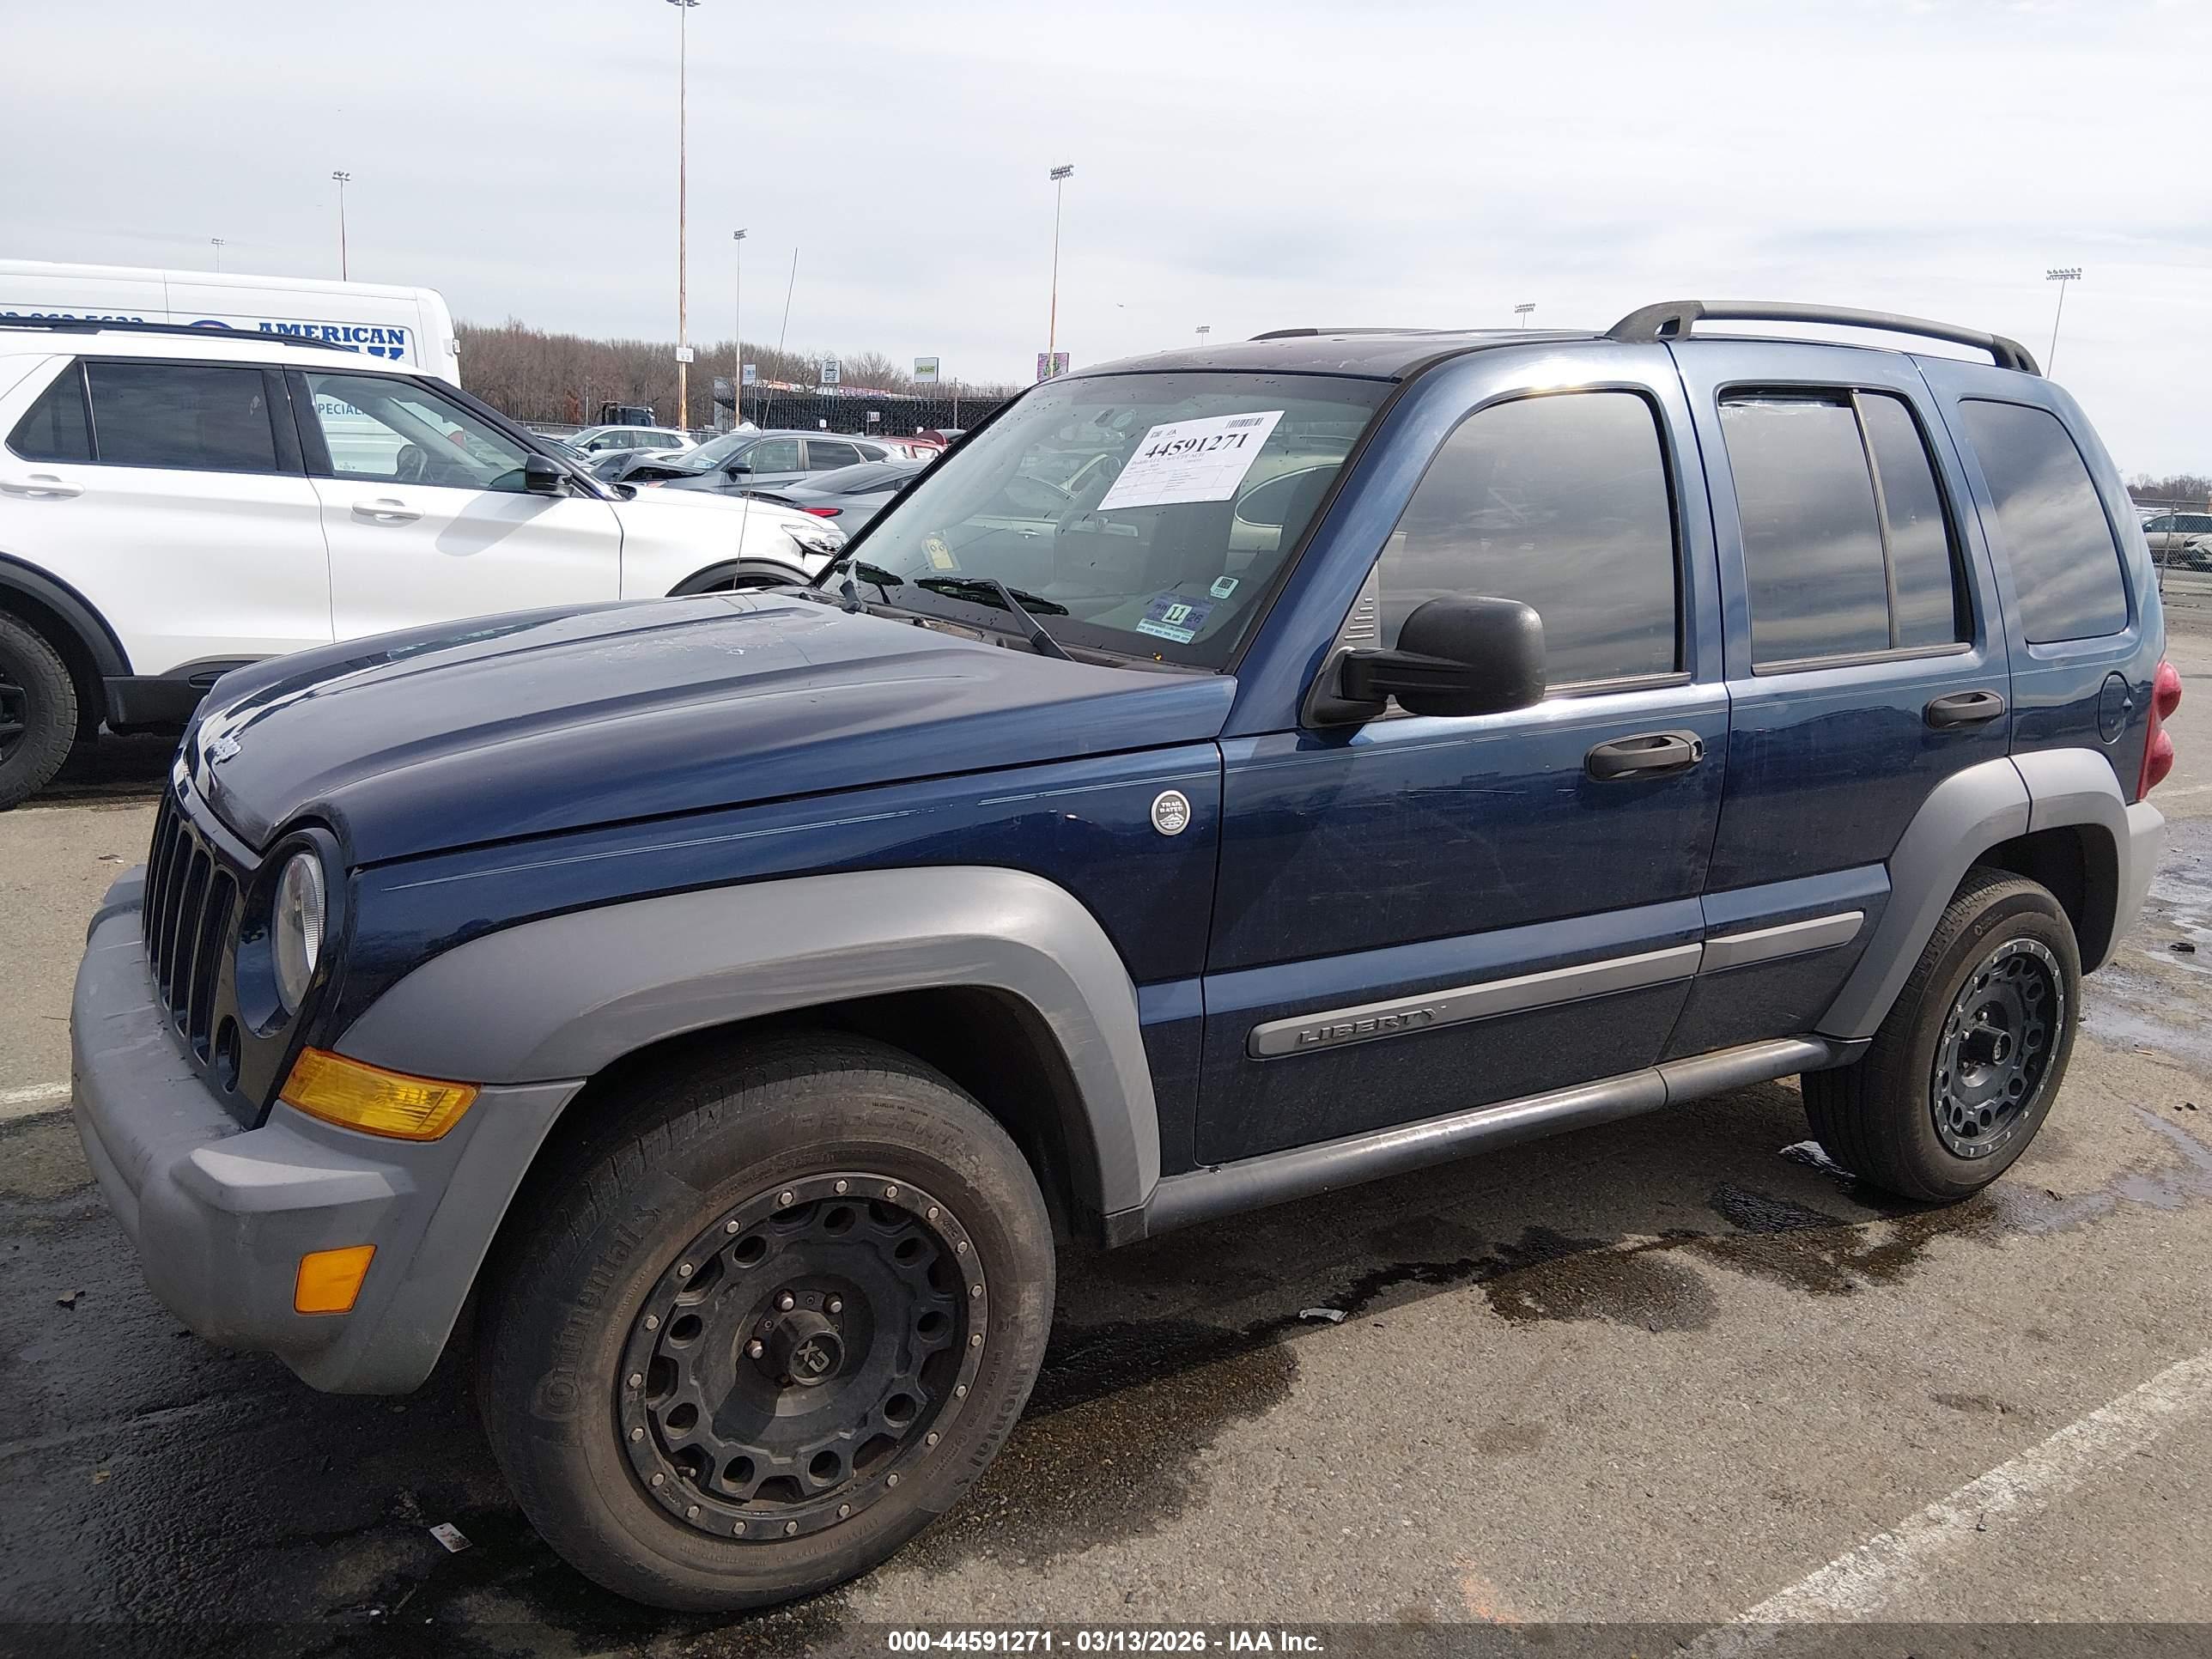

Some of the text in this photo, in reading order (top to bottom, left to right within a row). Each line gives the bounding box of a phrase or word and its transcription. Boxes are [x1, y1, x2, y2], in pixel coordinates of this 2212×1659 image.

[259, 323, 404, 344] AMERICAN
[318, 403, 364, 415] PECIAL
[1144, 432, 1250, 459] 44591271
[1166, 606, 1186, 621] 11
[1187, 613, 1203, 623] 26
[1299, 1008, 1437, 1044] LIBERTY
